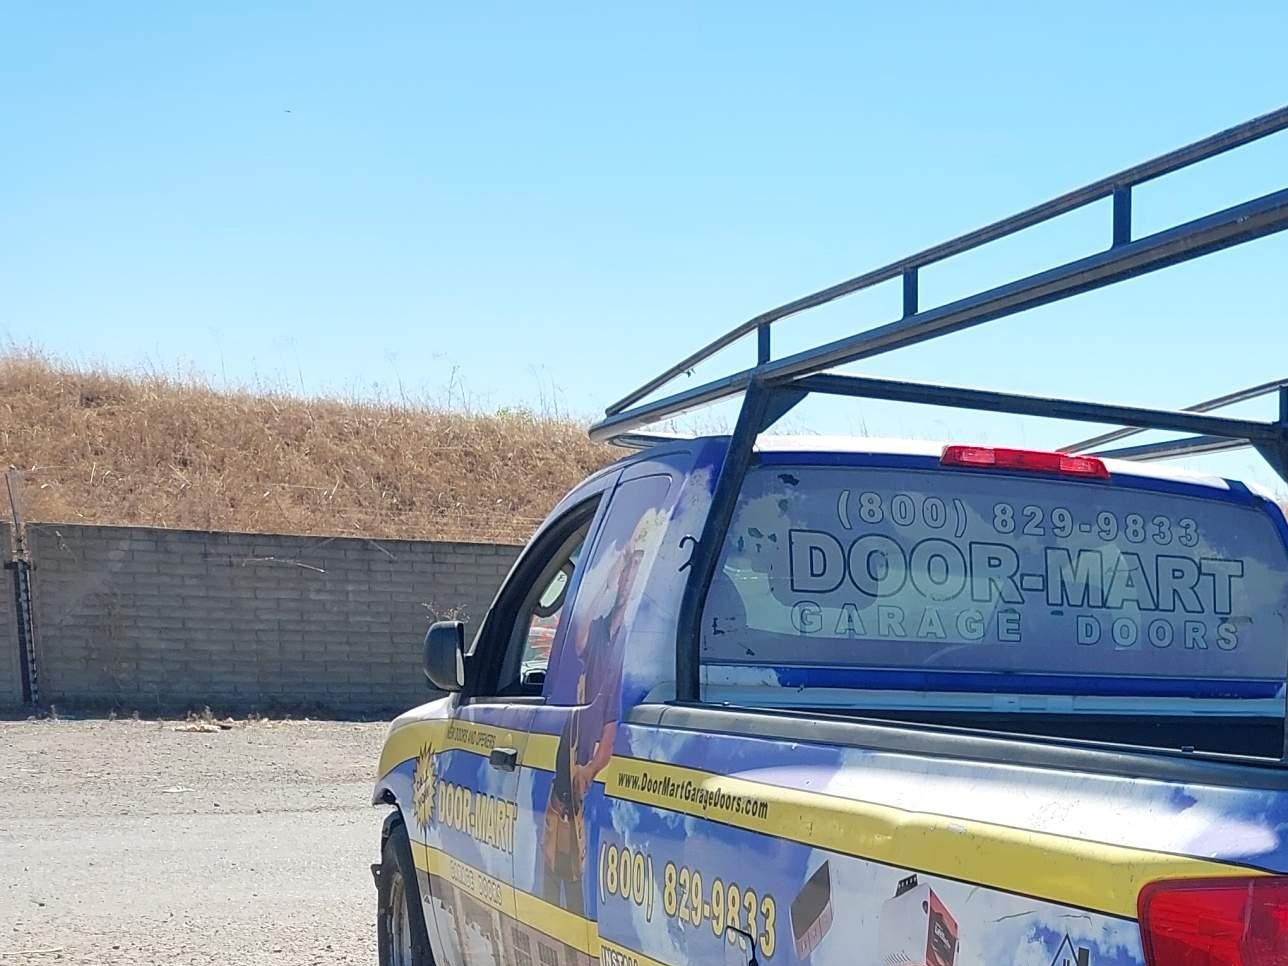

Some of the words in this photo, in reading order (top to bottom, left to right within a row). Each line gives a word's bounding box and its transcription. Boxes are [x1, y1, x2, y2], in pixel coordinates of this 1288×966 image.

[837, 490, 967, 538] (800)
[992, 503, 1201, 548] 829-9833
[789, 530, 1244, 615] DOOR-MART
[791, 601, 1022, 642] GARAGE
[1077, 616, 1239, 651] DOORS
[438, 779, 518, 854] DOOR-MART
[618, 772, 769, 819] www.DoorMartGarageDoors.com
[600, 843, 654, 922] (800)
[664, 861, 776, 958] 829-9833
